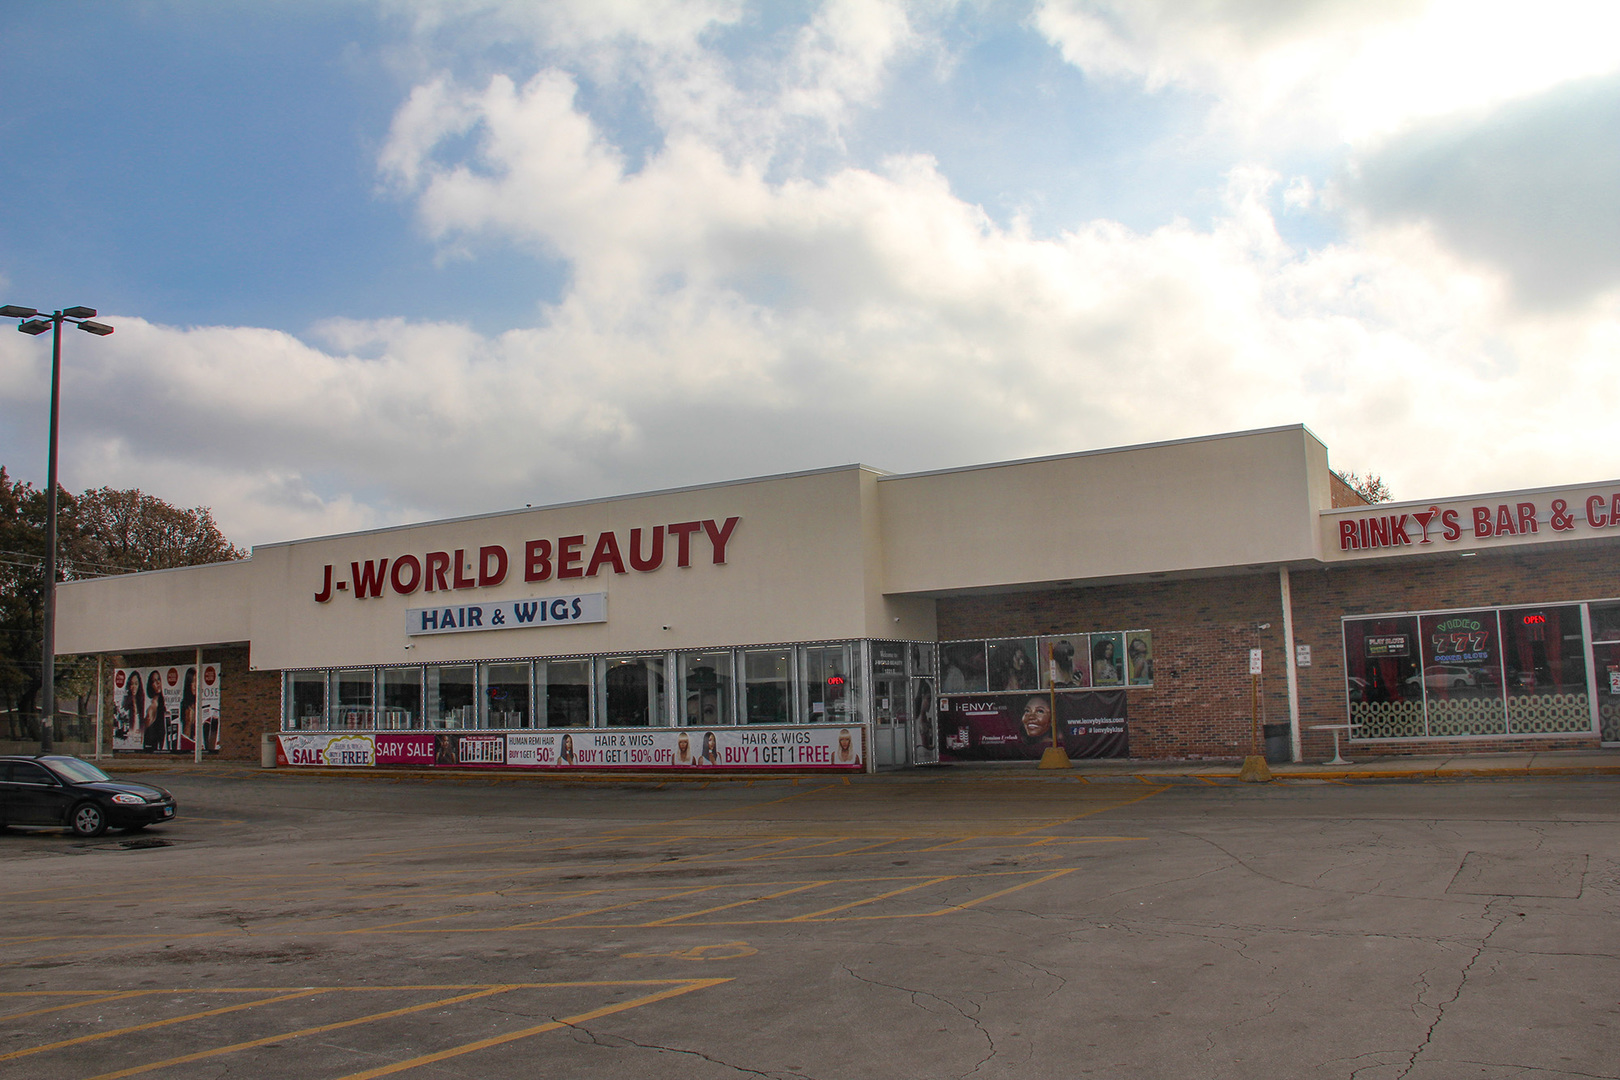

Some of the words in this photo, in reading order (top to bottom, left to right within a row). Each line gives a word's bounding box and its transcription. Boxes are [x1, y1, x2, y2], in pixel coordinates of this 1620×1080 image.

[1472, 502, 1540, 539] BAR
[1549, 498, 1575, 533] &
[314, 544, 509, 604] J-WORLD
[523, 516, 741, 584] BEAUTY
[421, 605, 483, 631] HAIR
[491, 608, 505, 626] &
[514, 597, 582, 624] WIGS
[1523, 615, 1546, 624] OPEN
[1436, 618, 1481, 632] VIDEO
[1463, 651, 1488, 660] SLOTS
[827, 676, 844, 685] OPEN
[509, 736, 528, 746] HUMAN
[528, 736, 542, 745] REMI
[542, 736, 555, 745] HAIR
[594, 735, 617, 746] HAIR
[619, 735, 626, 746] &
[629, 734, 654, 746] WIGS
[741, 732, 767, 745] HAIR
[770, 732, 778, 744] &
[781, 731, 811, 744] WIGS
[293, 748, 323, 764] SALE
[376, 742, 404, 757] SARY
[407, 742, 434, 756] SALE
[509, 750, 520, 759] BUY
[523, 750, 532, 758] GET
[579, 749, 596, 763] BUY
[599, 749, 604, 763] 1
[605, 749, 622, 763] GET
[624, 749, 629, 763] 1
[631, 749, 651, 763] 50%
[654, 748, 672, 763] OFF
[725, 746, 750, 763] BUY
[752, 746, 759, 763] 1
[762, 746, 785, 763] GET
[788, 746, 795, 763] 1
[799, 745, 829, 763] FREE
[341, 751, 369, 764] FREE
